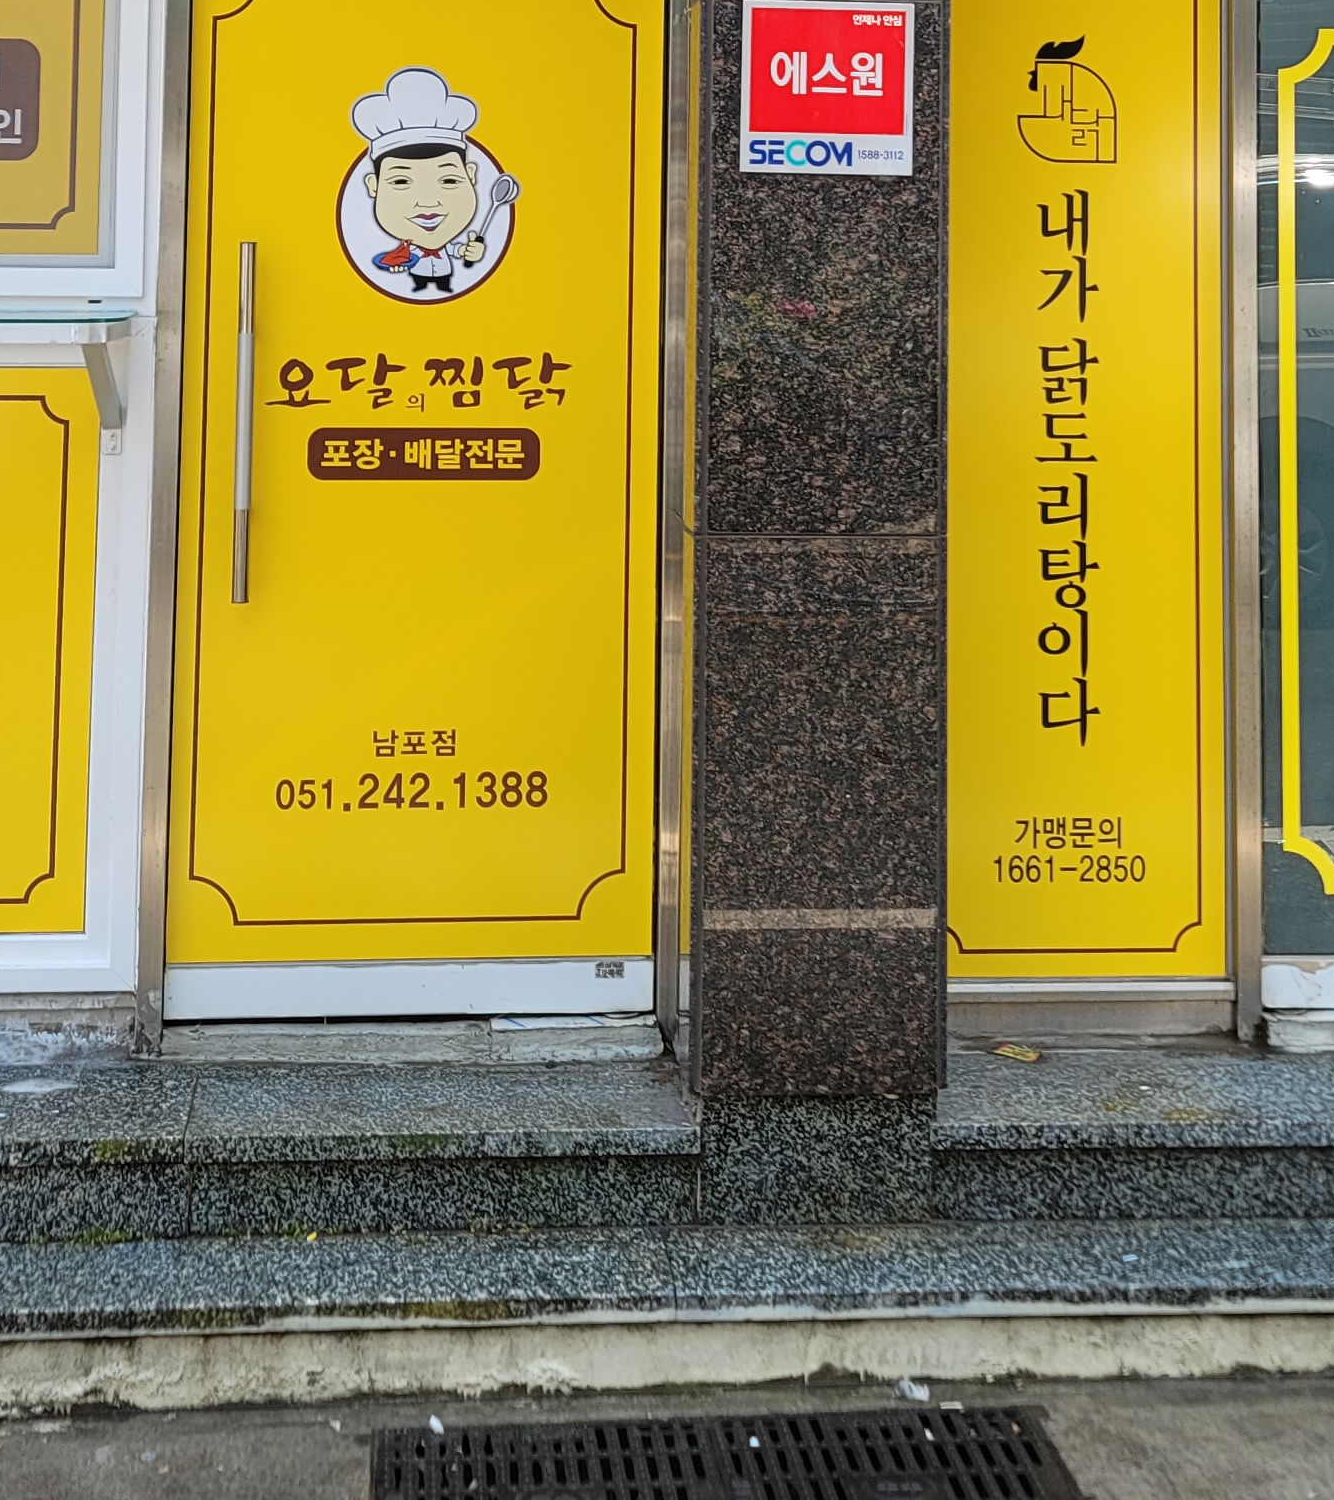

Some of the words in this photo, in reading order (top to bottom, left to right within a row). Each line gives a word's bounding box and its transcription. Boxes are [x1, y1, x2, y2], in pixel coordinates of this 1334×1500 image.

[853, 14, 881, 26] 언제나
[882, 14, 903, 27] 안심
[770, 51, 884, 97] 에스원
[749, 139, 853, 167] SECOM
[857, 149, 904, 161] 1588-3112
[1036, 188, 1100, 323] 내가
[1034, 337, 1101, 747] 닭도리탕이다
[372, 728, 456, 758] 남포점
[275, 770, 548, 812] 051.242.1388
[1014, 816, 1122, 850] 가맹문의
[993, 854, 1146, 884] 1661-2850
